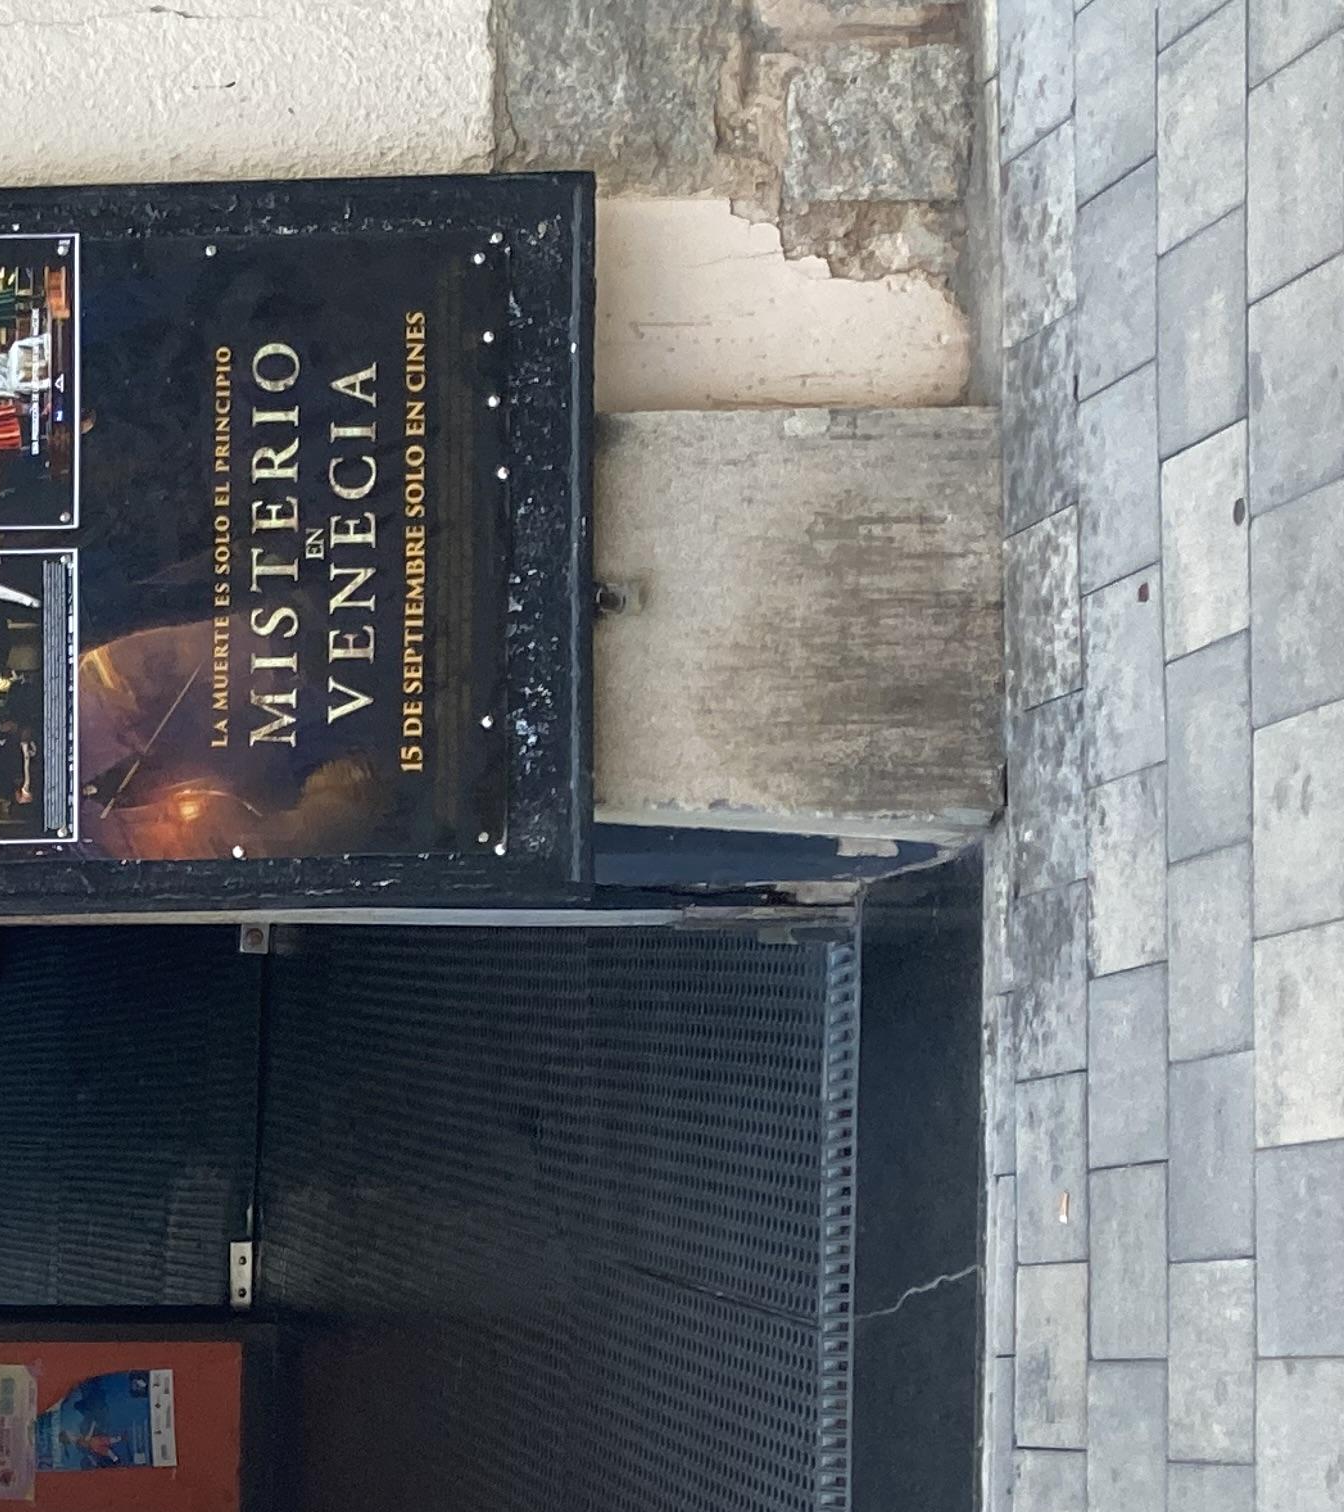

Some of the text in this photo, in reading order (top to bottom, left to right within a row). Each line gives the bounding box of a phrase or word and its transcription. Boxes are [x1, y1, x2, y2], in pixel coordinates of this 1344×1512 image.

[211, 345, 232, 748] LA MUERTE ES SOLO EL PRINCIPIO
[248, 341, 302, 748] MISTERIO
[305, 527, 326, 560] EN
[326, 361, 378, 725] VENECIA
[401, 311, 427, 773] 15 DE SEPTIEMBRE SOLO EN CINES
